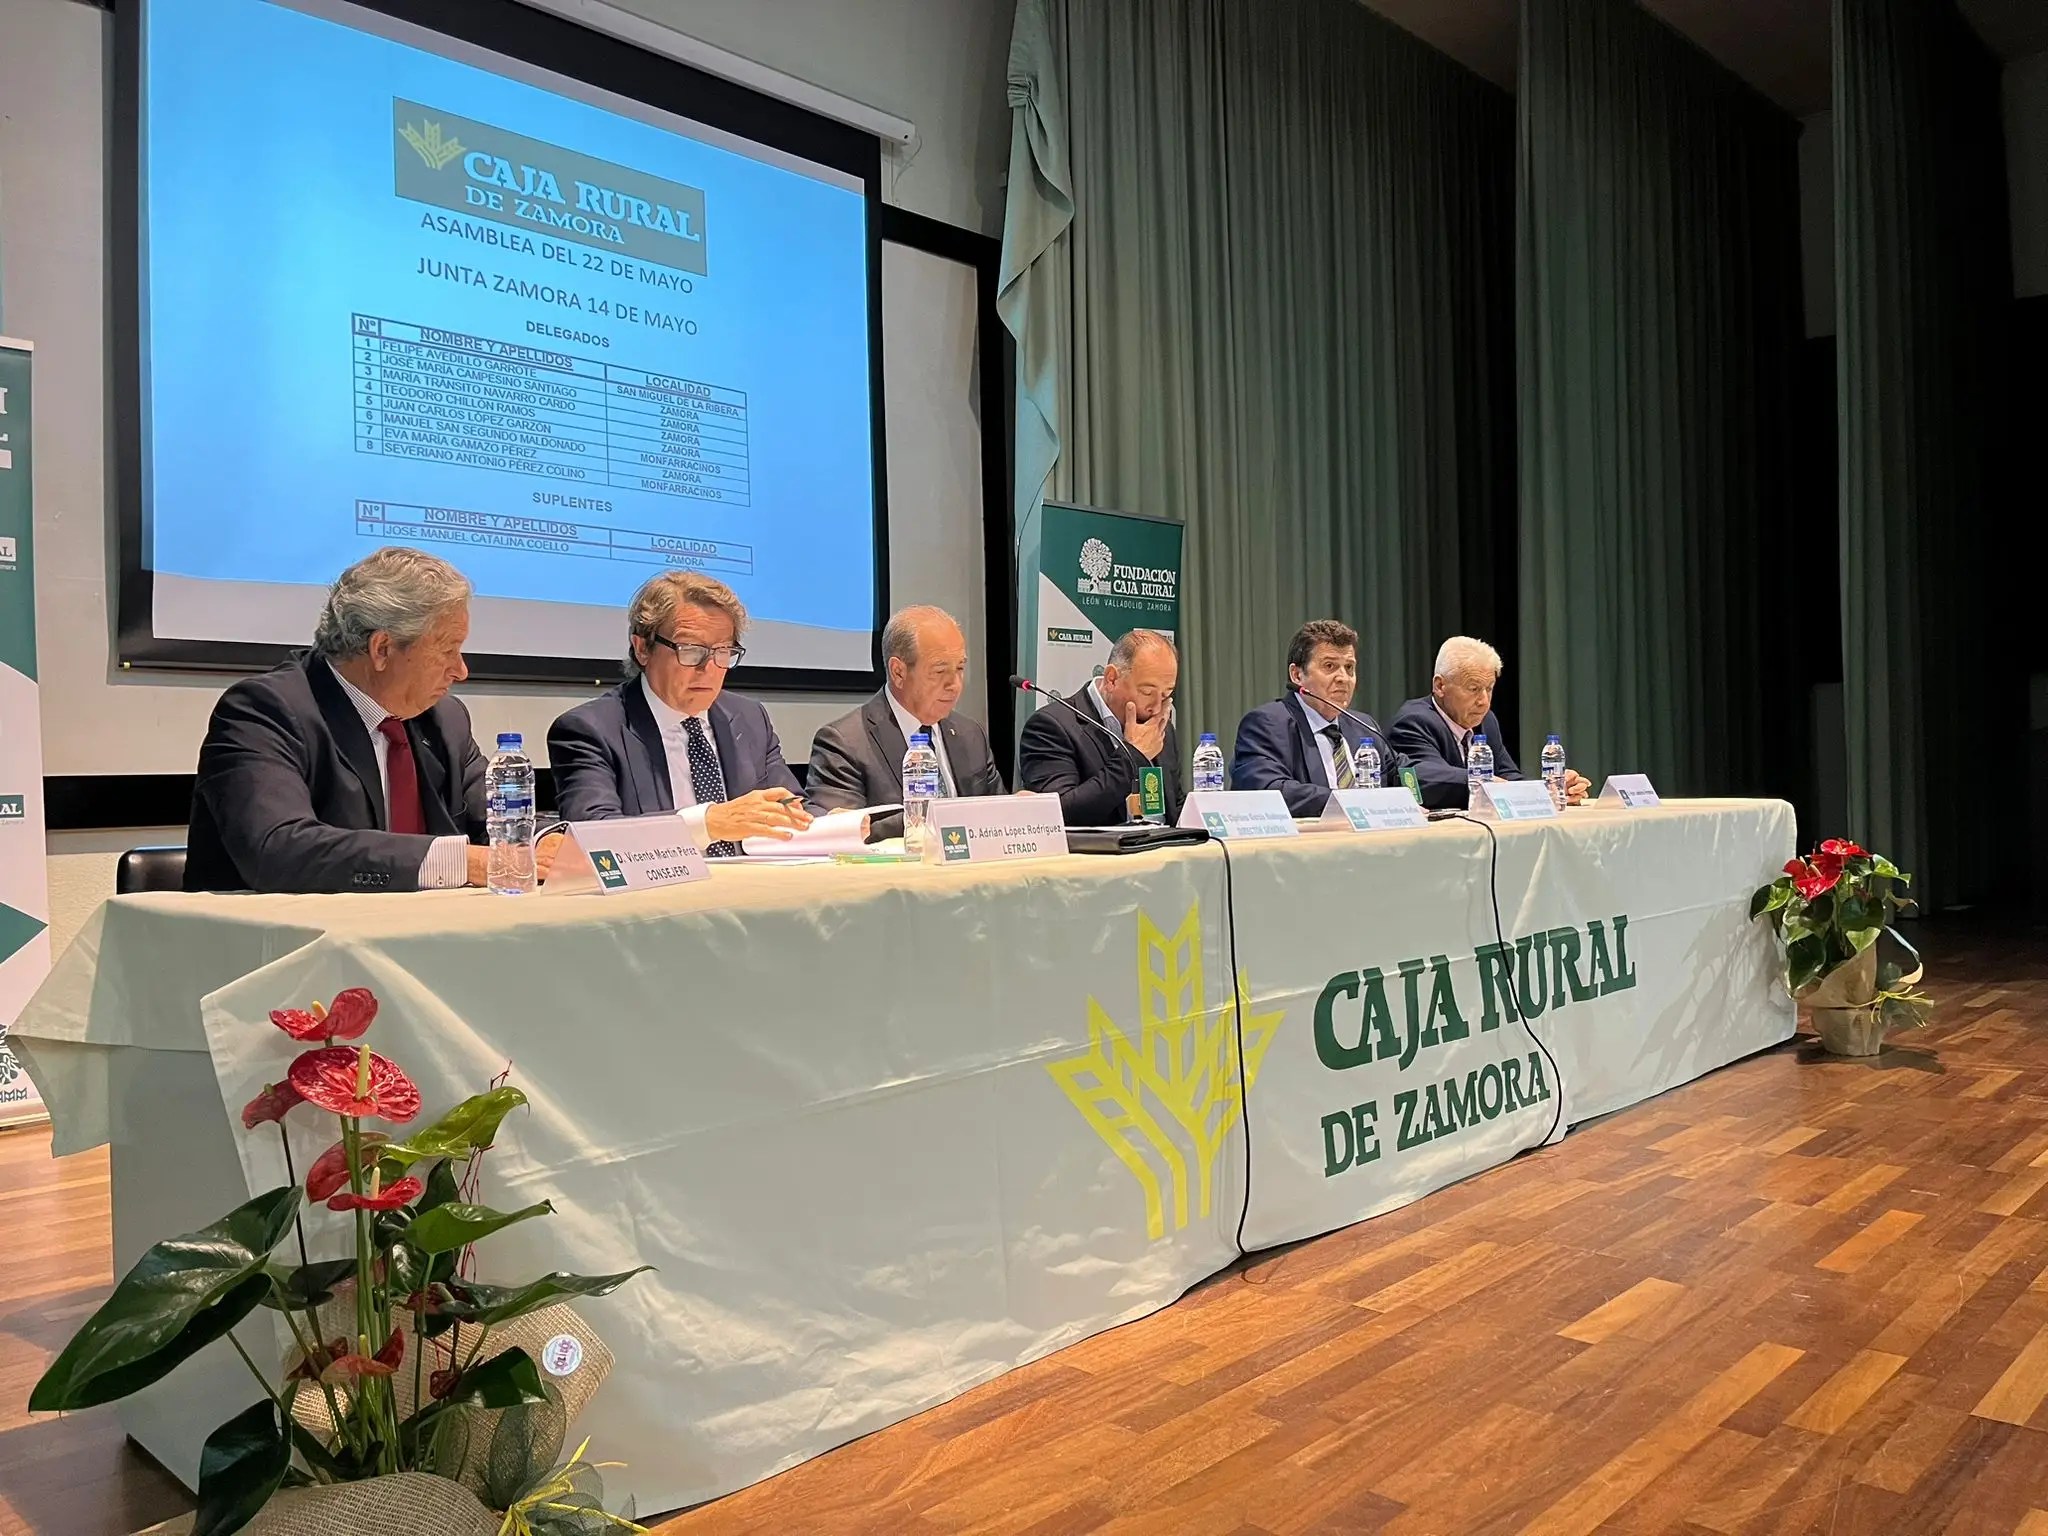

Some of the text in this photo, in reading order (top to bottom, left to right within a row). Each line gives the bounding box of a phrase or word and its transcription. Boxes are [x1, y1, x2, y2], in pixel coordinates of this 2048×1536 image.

[463, 152, 700, 242] CAJA RURAL
[465, 185, 624, 244] DE ZAMORA
[421, 212, 693, 294] ASAMBLEA DEL 22 DE MAYO
[417, 258, 697, 335] JUNTA ZAMORA 14 DE MAYO
[359, 318, 376, 332] Nº
[526, 320, 609, 348] DELEGADOS
[365, 338, 370, 347] 1
[420, 328, 573, 368] NOMBRE Y APELLIDOS
[365, 352, 372, 361] 2
[382, 340, 537, 378] FELIPE AVEDILLO GARROTE
[365, 367, 372, 376] 3
[365, 382, 372, 391] 4
[456, 368, 522, 388] CAMPESINO
[524, 381, 577, 398] SANTIAGO
[645, 375, 711, 397] LOCALIDAD
[366, 396, 373, 405] 5
[384, 384, 443, 402] TEODORO
[496, 404, 536, 418] RAMOS
[484, 386, 536, 404] NAVARRO
[539, 397, 576, 411] CARDO
[617, 386, 738, 416] SAN MIGUEL DE LA RIBERA
[366, 411, 373, 420] 6
[384, 399, 415, 412] JUAN
[418, 405, 465, 420] CARLOS
[660, 405, 699, 420] ZAMORA
[366, 426, 373, 435] 7
[384, 413, 586, 453] MANUEL SAN SEGUNDO MALDONADO
[660, 418, 700, 433] ZAMORA
[367, 440, 373, 449] 8
[384, 428, 409, 440] EVA
[451, 439, 499, 453] GAMAZO
[661, 431, 700, 446] ZAMORA
[384, 443, 453, 460] SEVERIANO
[456, 453, 506, 468] ANTONIO
[546, 466, 585, 479] COLINO
[661, 444, 701, 459] ZAMORA
[640, 454, 721, 474] MONFARRACINOS
[662, 470, 701, 484] ZAMORA
[641, 479, 722, 499] MONFARRACINOS
[362, 504, 380, 517] Nº
[532, 492, 612, 512] SUPLENTES
[368, 524, 373, 533] 1
[424, 508, 578, 536] NOMBRE Y APELLIDOS
[420, 528, 469, 542] MANUEL
[471, 533, 525, 548] CATALINA
[527, 539, 569, 552] COELLO
[651, 537, 717, 554] LOCALIDAD
[665, 555, 704, 567] ZAMORA
[1113, 564, 1176, 585] FUNDACIÓN
[1113, 580, 1175, 598] CAJA RURAL
[1104, 599, 1143, 610] VALLADOLID
[1147, 602, 1172, 612] ZAMORA
[968, 829, 977, 839] D.
[979, 827, 1003, 839] Adrián
[615, 853, 625, 864] D.
[626, 851, 655, 863] Vicente
[1003, 842, 1037, 854] LETRADO
[646, 865, 690, 881] CONSEJERO
[1313, 915, 1637, 1071] CAJA RURAL
[1320, 1052, 1551, 1178] DE ZAMORA
